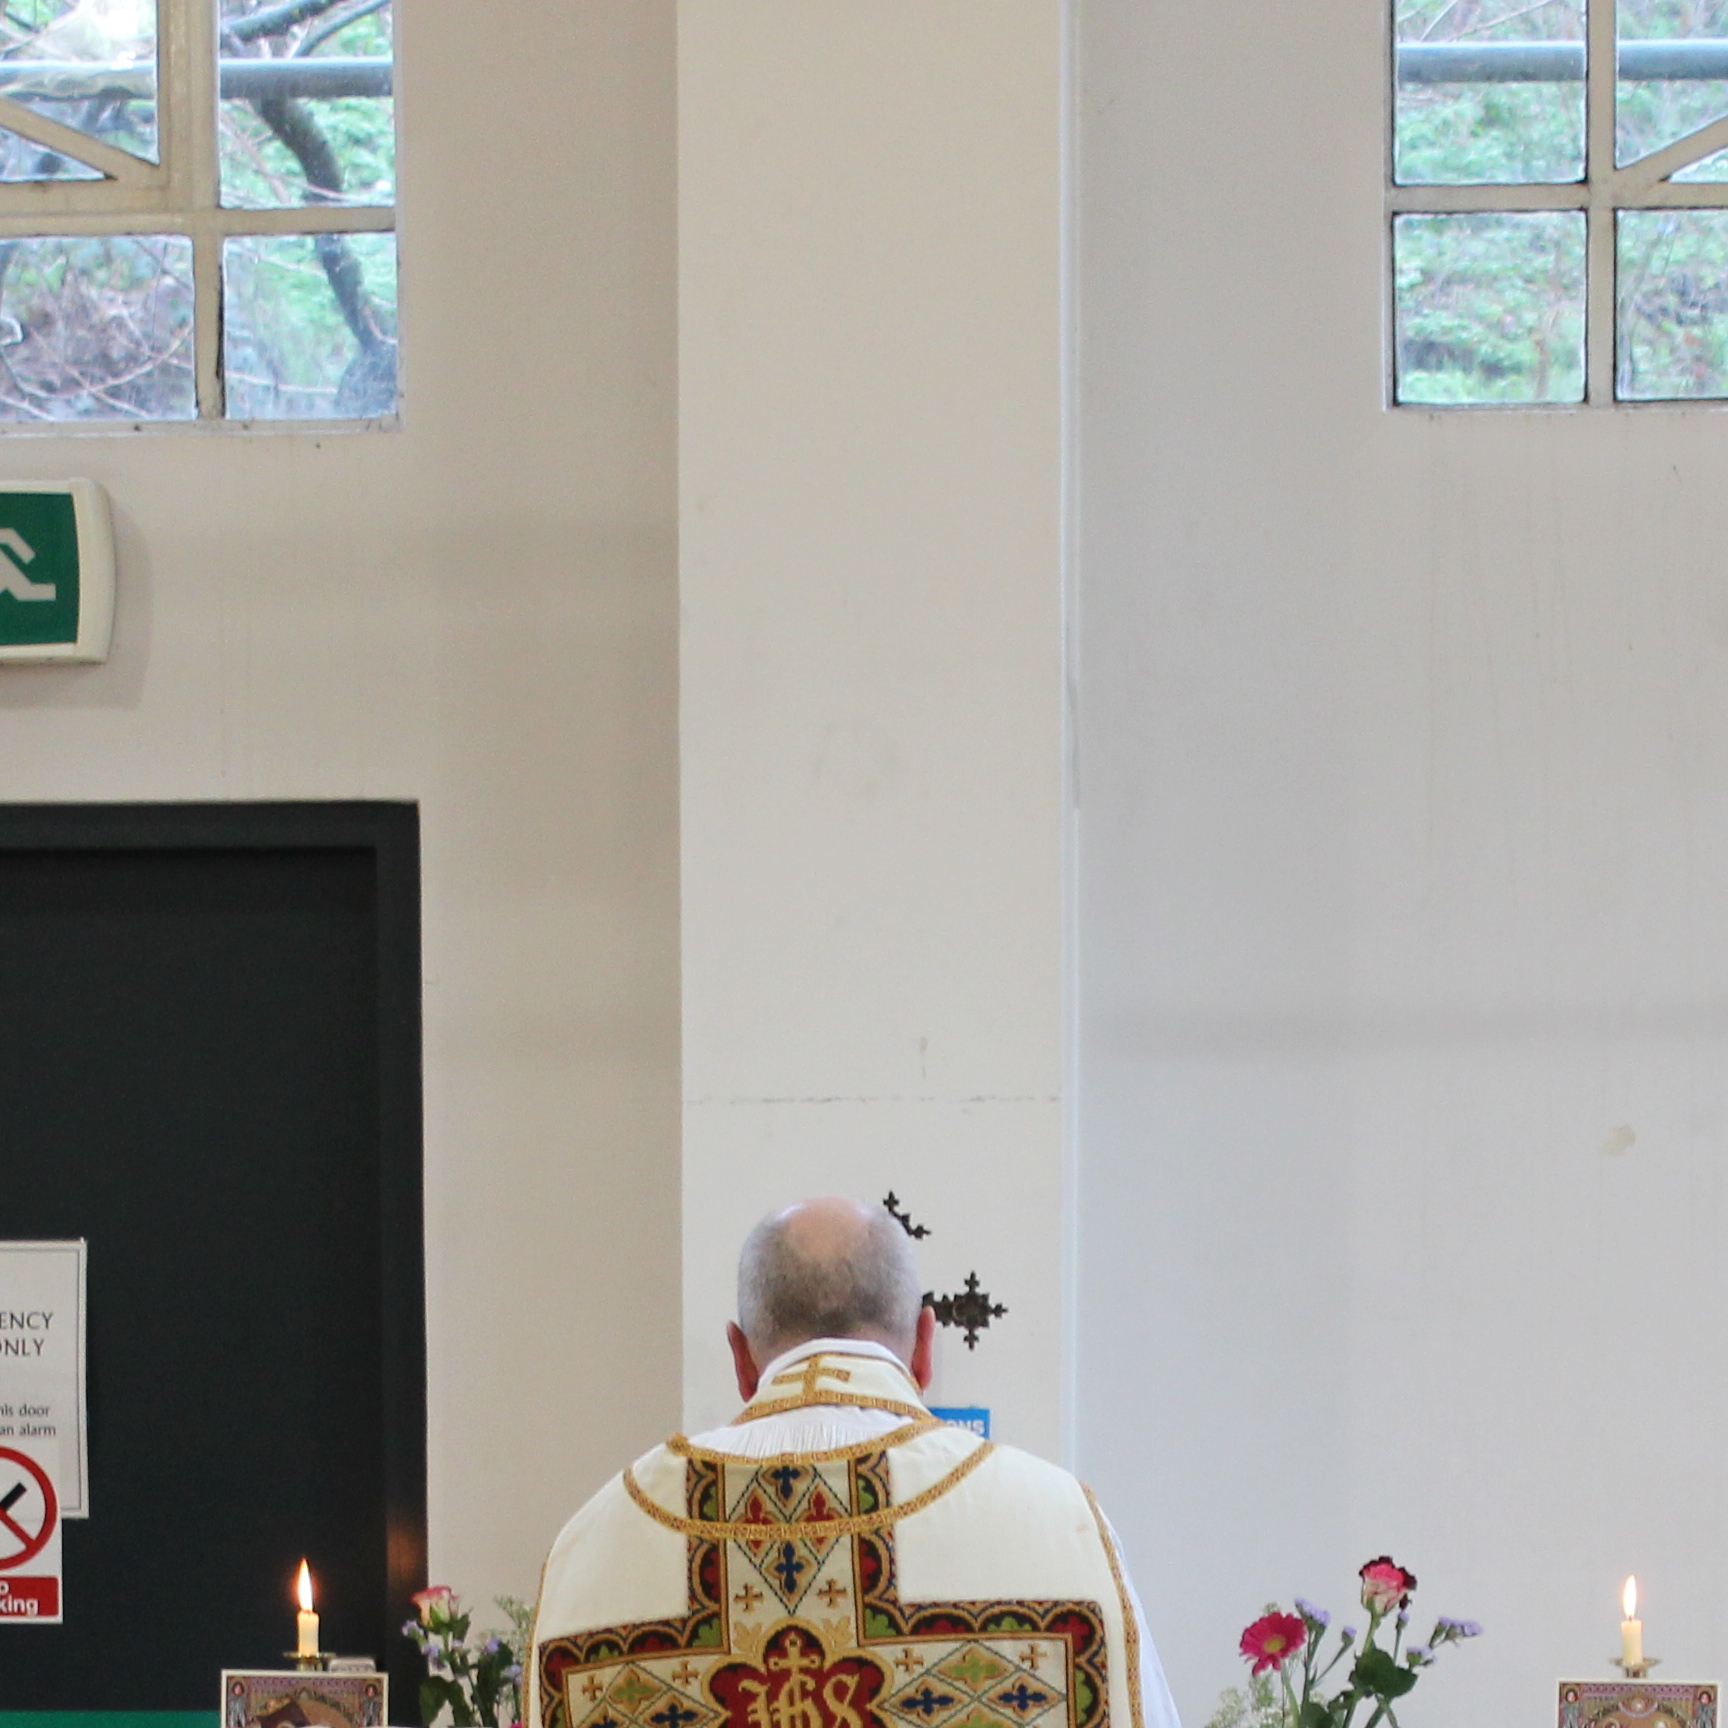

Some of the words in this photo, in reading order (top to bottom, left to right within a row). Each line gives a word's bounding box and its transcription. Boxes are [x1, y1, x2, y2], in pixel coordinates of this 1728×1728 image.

[19, 1402, 51, 1417] door
[0, 1424, 15, 1436] an
[20, 1422, 57, 1436] alarm
